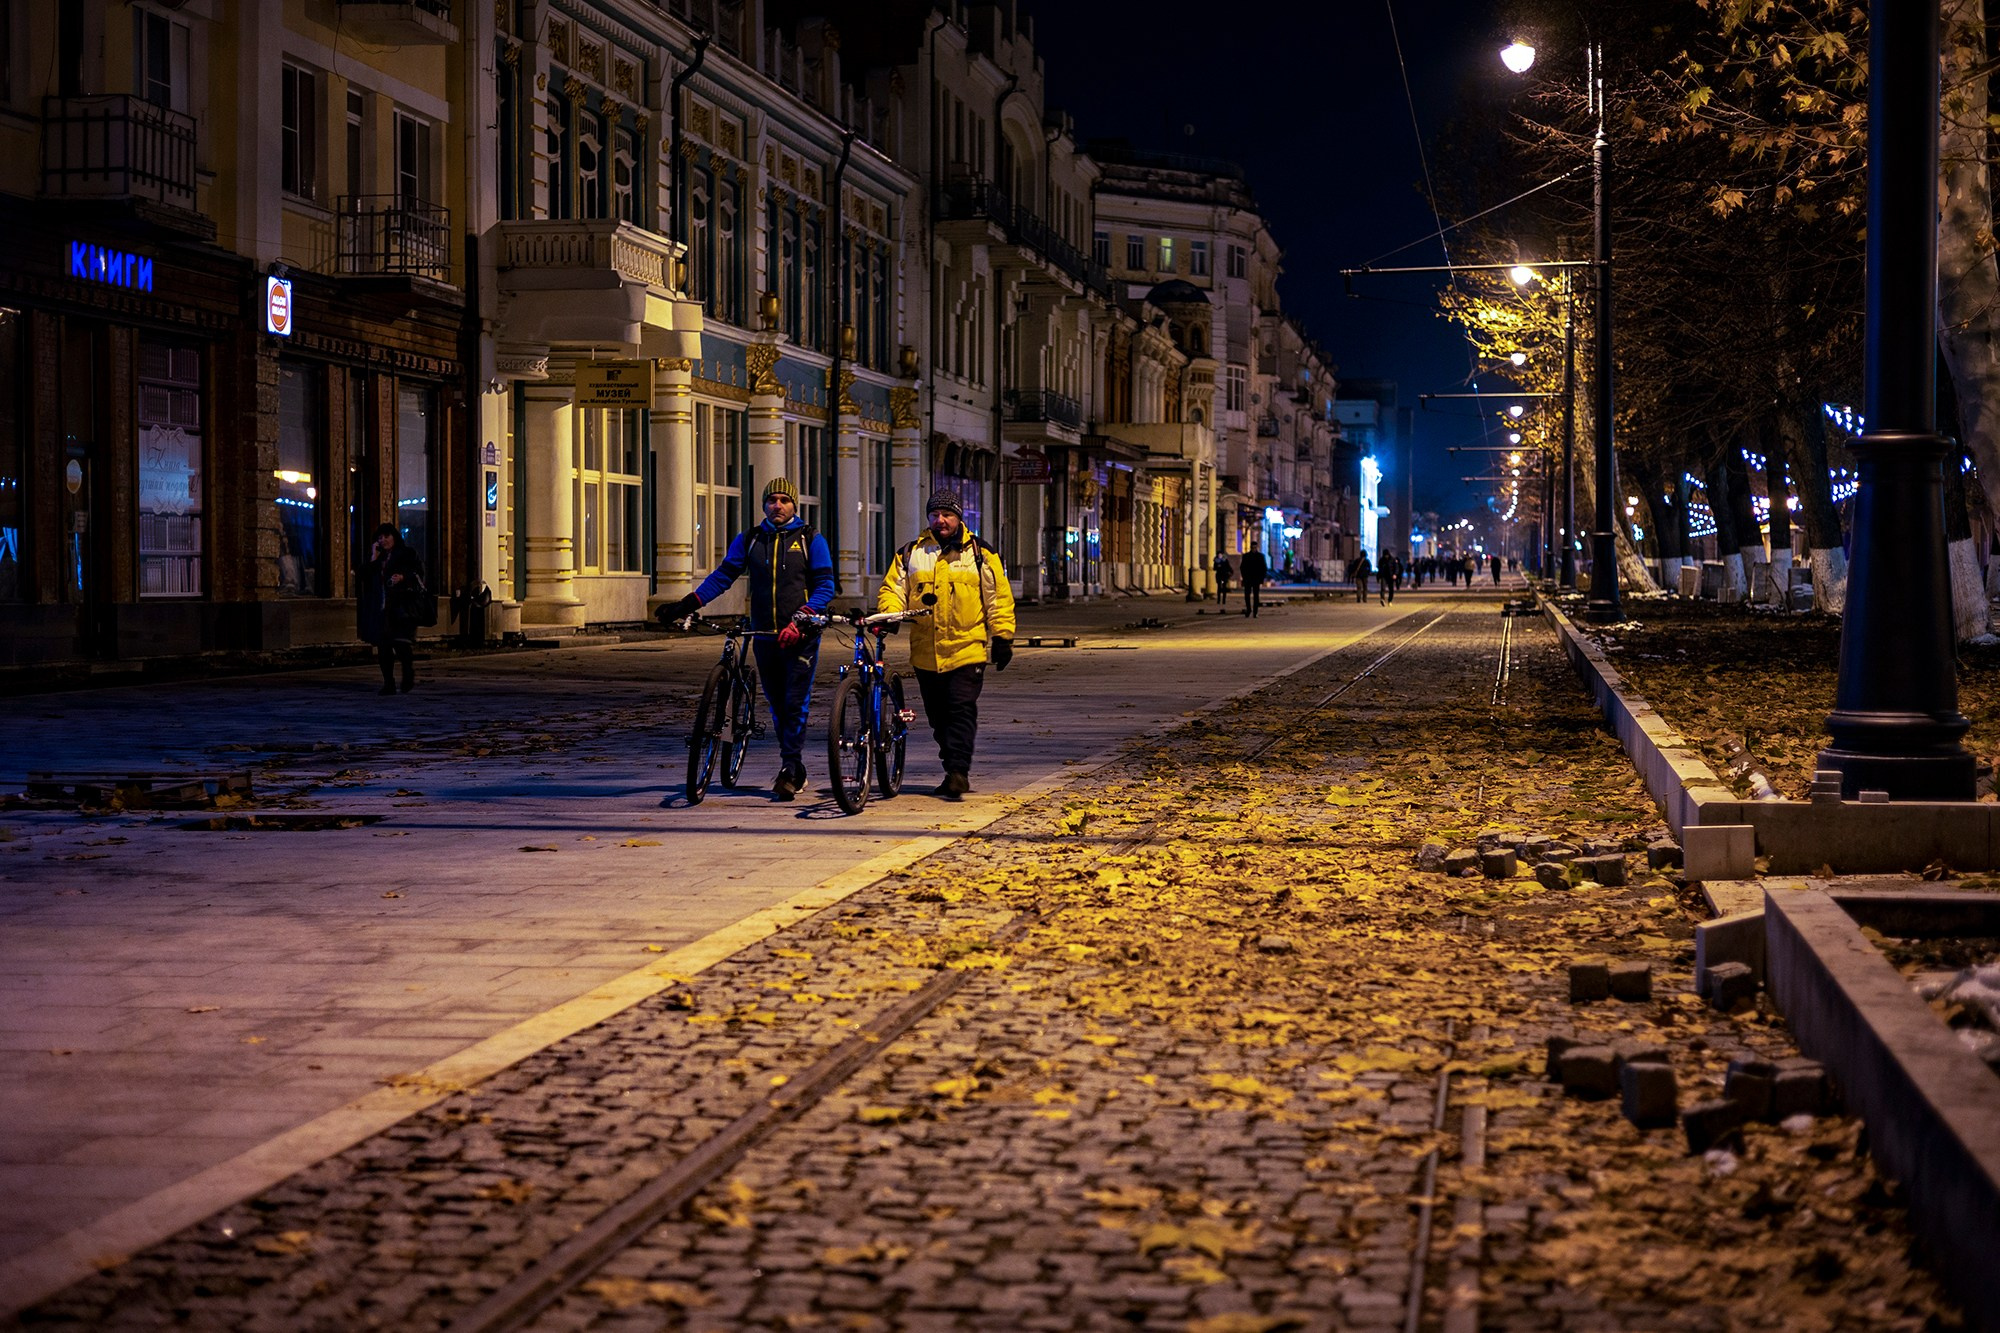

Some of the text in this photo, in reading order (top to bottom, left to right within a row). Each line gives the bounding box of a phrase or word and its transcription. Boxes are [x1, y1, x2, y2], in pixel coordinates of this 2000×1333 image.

[71, 240, 153, 293] КНИГИ
[596, 388, 631, 398] МУЗЕЙ
[139, 476, 164, 496] учший
